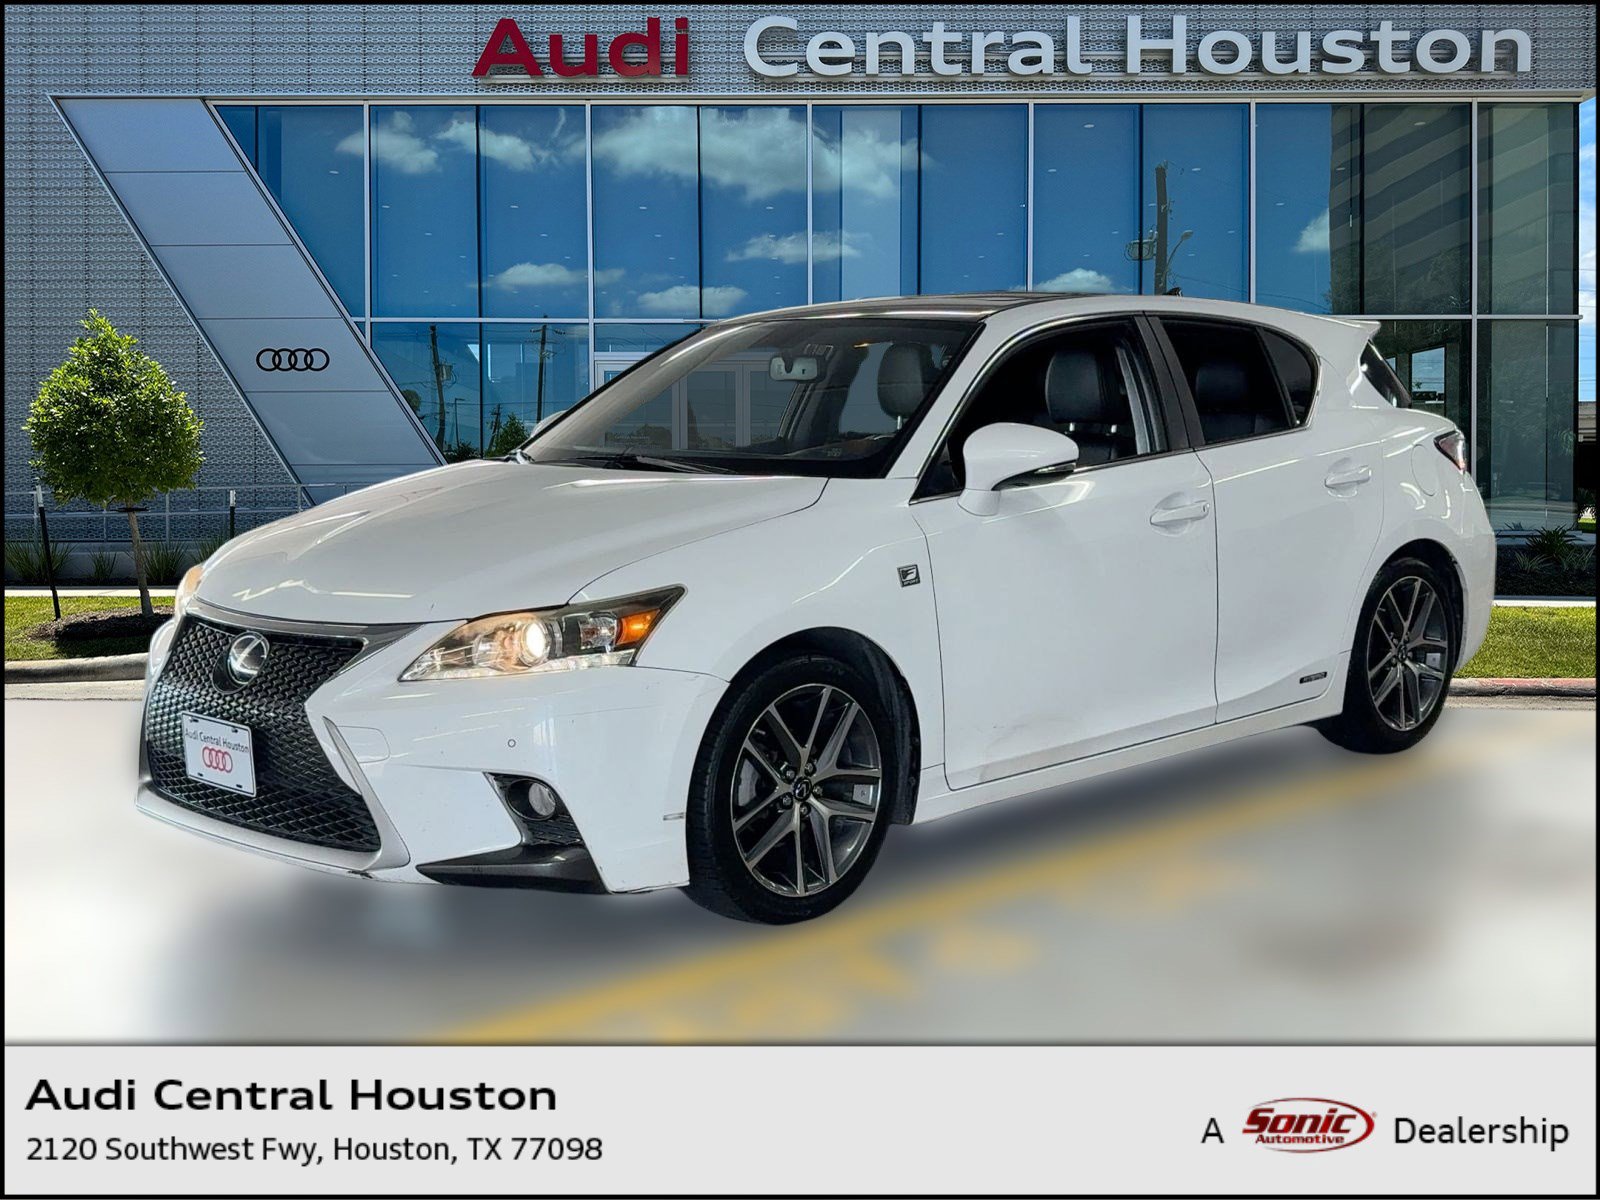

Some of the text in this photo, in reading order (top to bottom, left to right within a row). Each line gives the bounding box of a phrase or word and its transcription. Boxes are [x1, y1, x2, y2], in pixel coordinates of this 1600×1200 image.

[472, 15, 1532, 78] Audi Central Houston
[199, 731, 222, 747] Central
[222, 737, 250, 753] Houston
